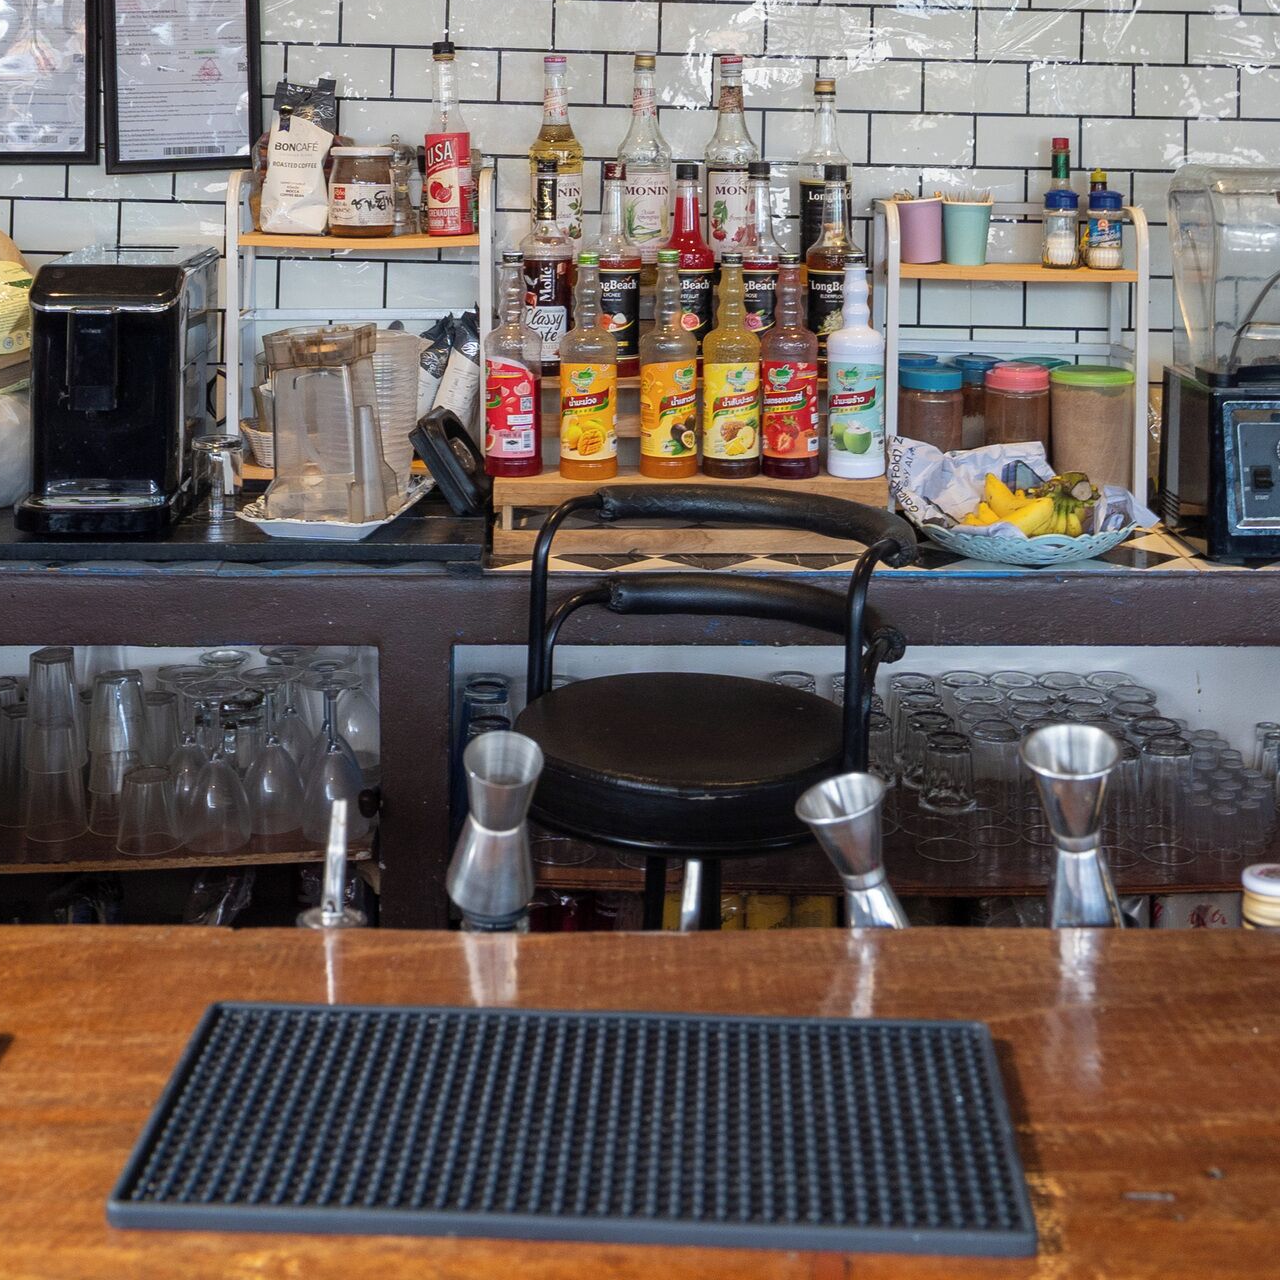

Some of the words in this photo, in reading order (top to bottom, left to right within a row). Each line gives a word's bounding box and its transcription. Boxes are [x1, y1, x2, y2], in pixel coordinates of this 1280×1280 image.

[274, 141, 319, 152] BONCAFÉ
[558, 188, 581, 197] NIN
[624, 185, 669, 196] MONIN
[715, 185, 748, 195] MON
[428, 208, 459, 218] GRENADINE
[600, 278, 637, 292] ngBeach
[810, 280, 844, 293] LongBe
